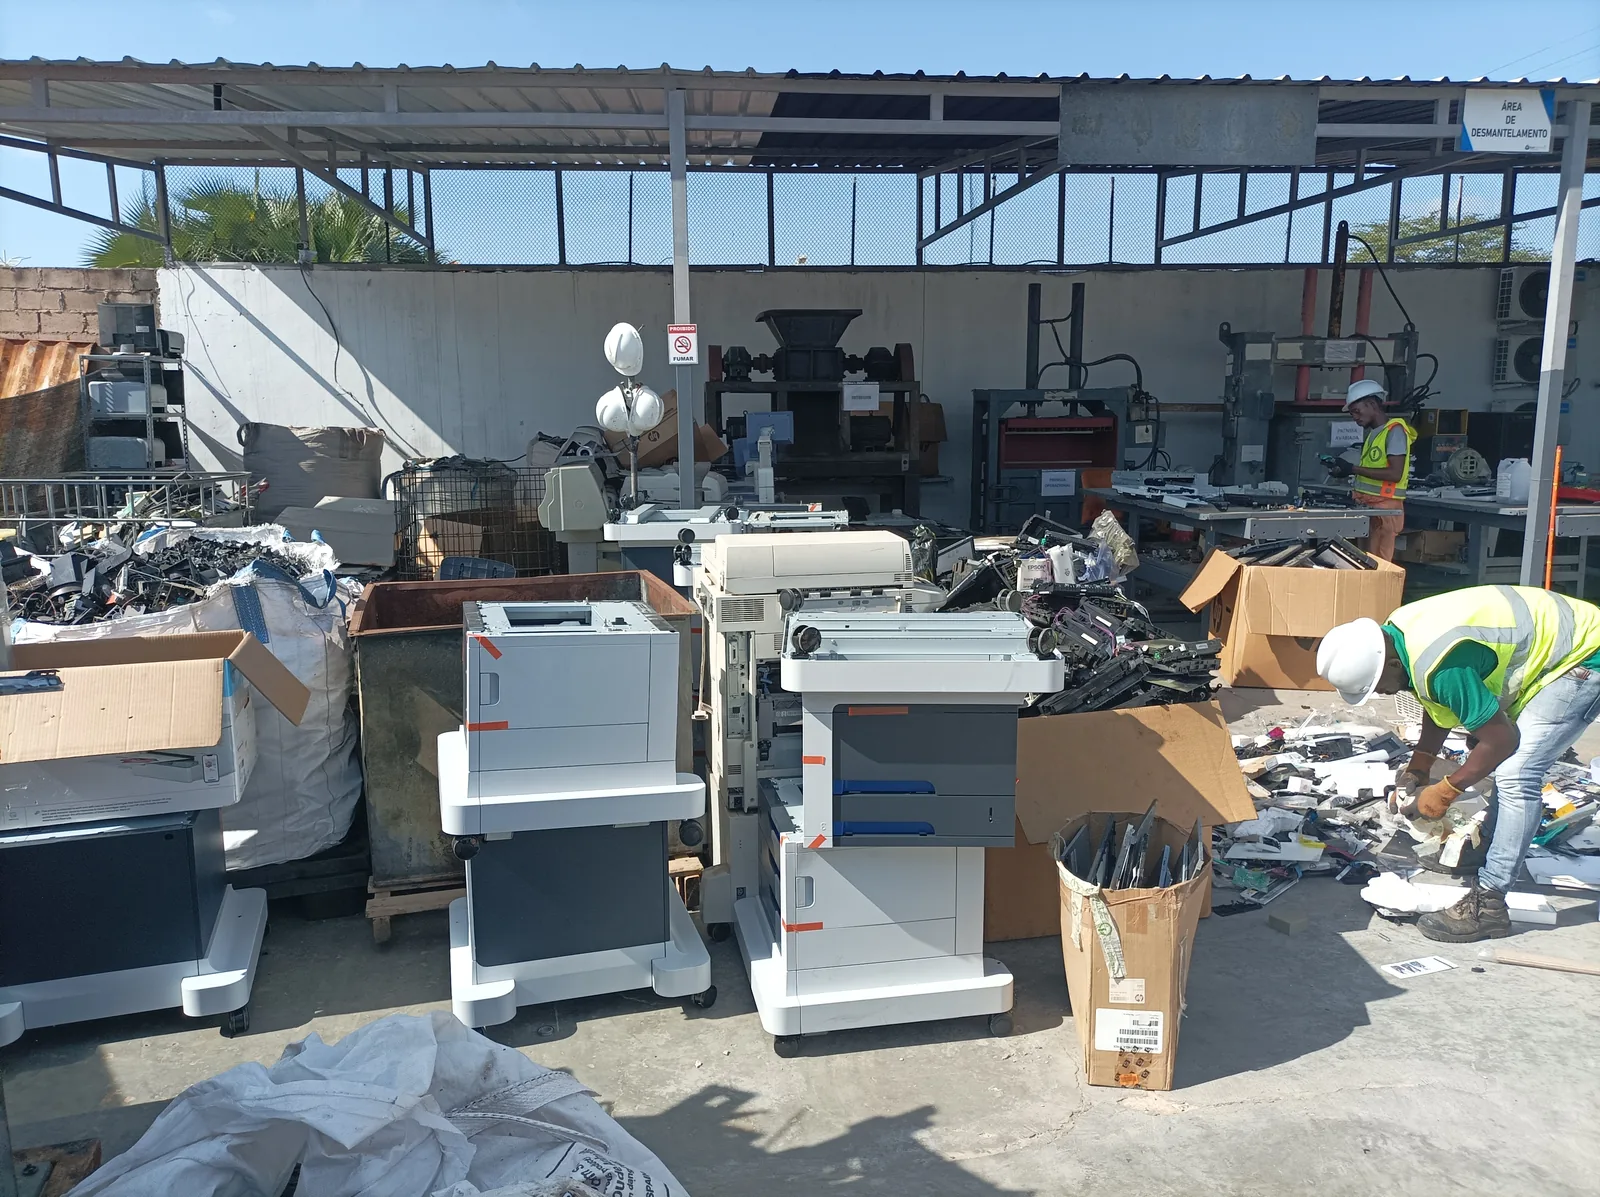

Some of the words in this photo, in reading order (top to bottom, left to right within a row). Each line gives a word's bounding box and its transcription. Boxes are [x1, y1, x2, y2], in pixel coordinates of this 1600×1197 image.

[1501, 100, 1522, 111] ÁREA
[1505, 115, 1516, 124] DE
[1471, 128, 1548, 138] DESMANTELAMENTO
